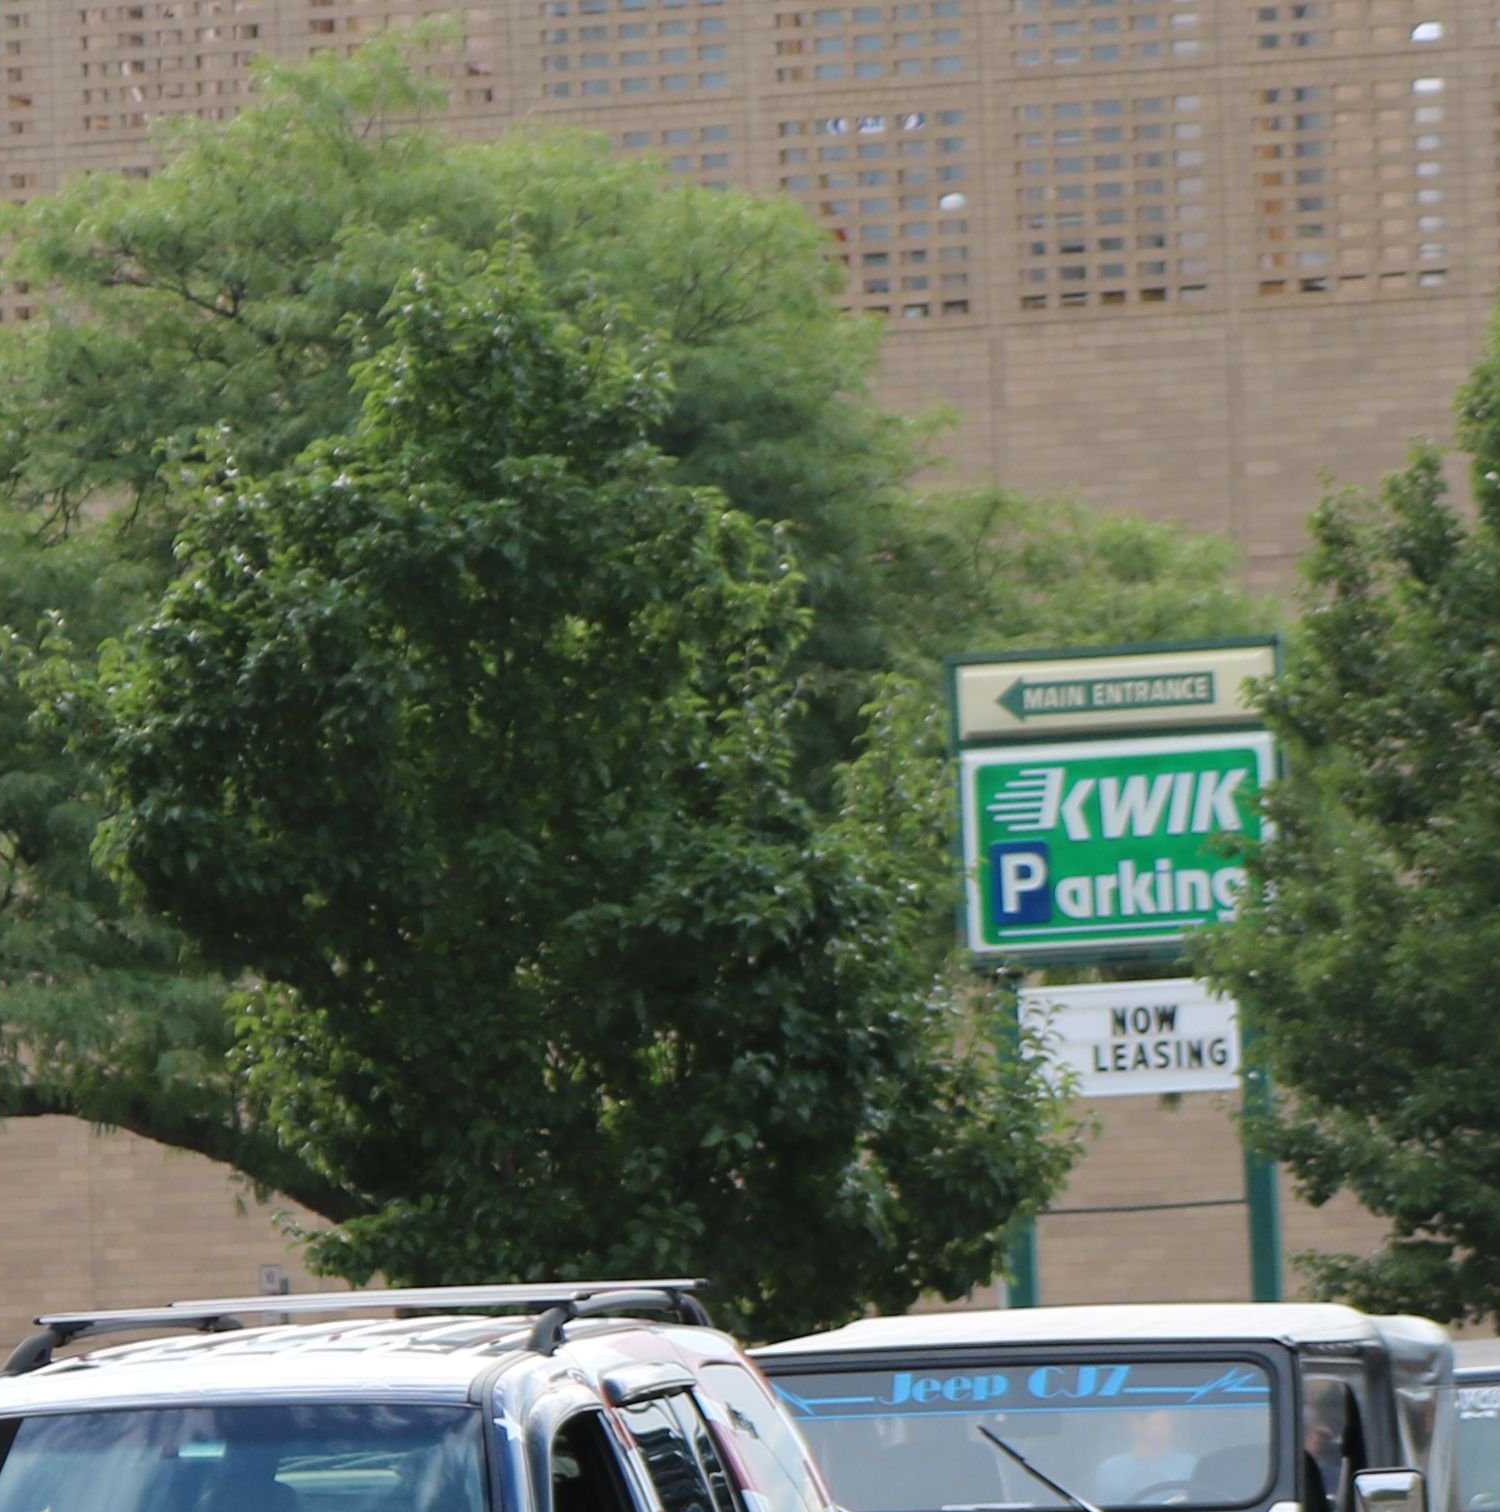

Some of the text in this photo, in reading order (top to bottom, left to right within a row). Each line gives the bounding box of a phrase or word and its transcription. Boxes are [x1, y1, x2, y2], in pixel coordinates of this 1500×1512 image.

[1023, 674, 1209, 709] MAIN ENTRANCE
[994, 766, 1249, 841] KWIK
[1001, 852, 1246, 923] Parking
[1109, 1004, 1178, 1036] NOW
[1092, 1038, 1229, 1073] LEASING
[878, 1365, 1132, 1405] Jeep CJ7
